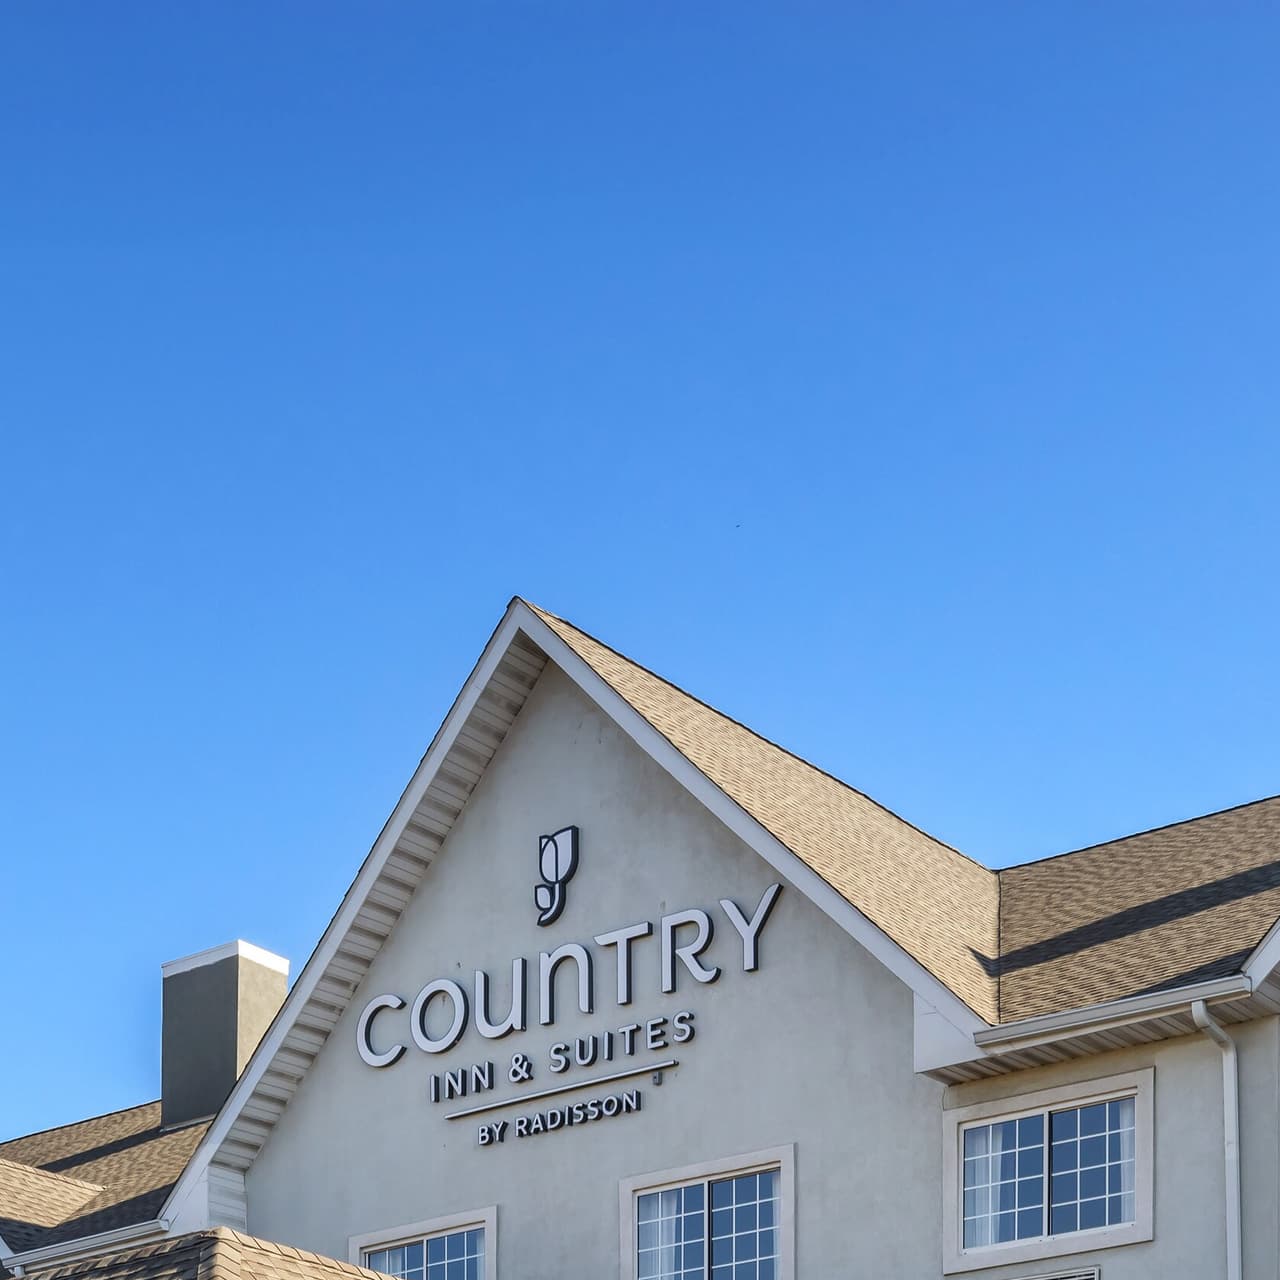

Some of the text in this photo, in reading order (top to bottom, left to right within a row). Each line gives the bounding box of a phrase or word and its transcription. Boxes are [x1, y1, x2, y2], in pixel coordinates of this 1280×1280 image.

[429, 1011, 696, 1102] INN & SUITES
[478, 1090, 642, 1145] BY RADISSON
